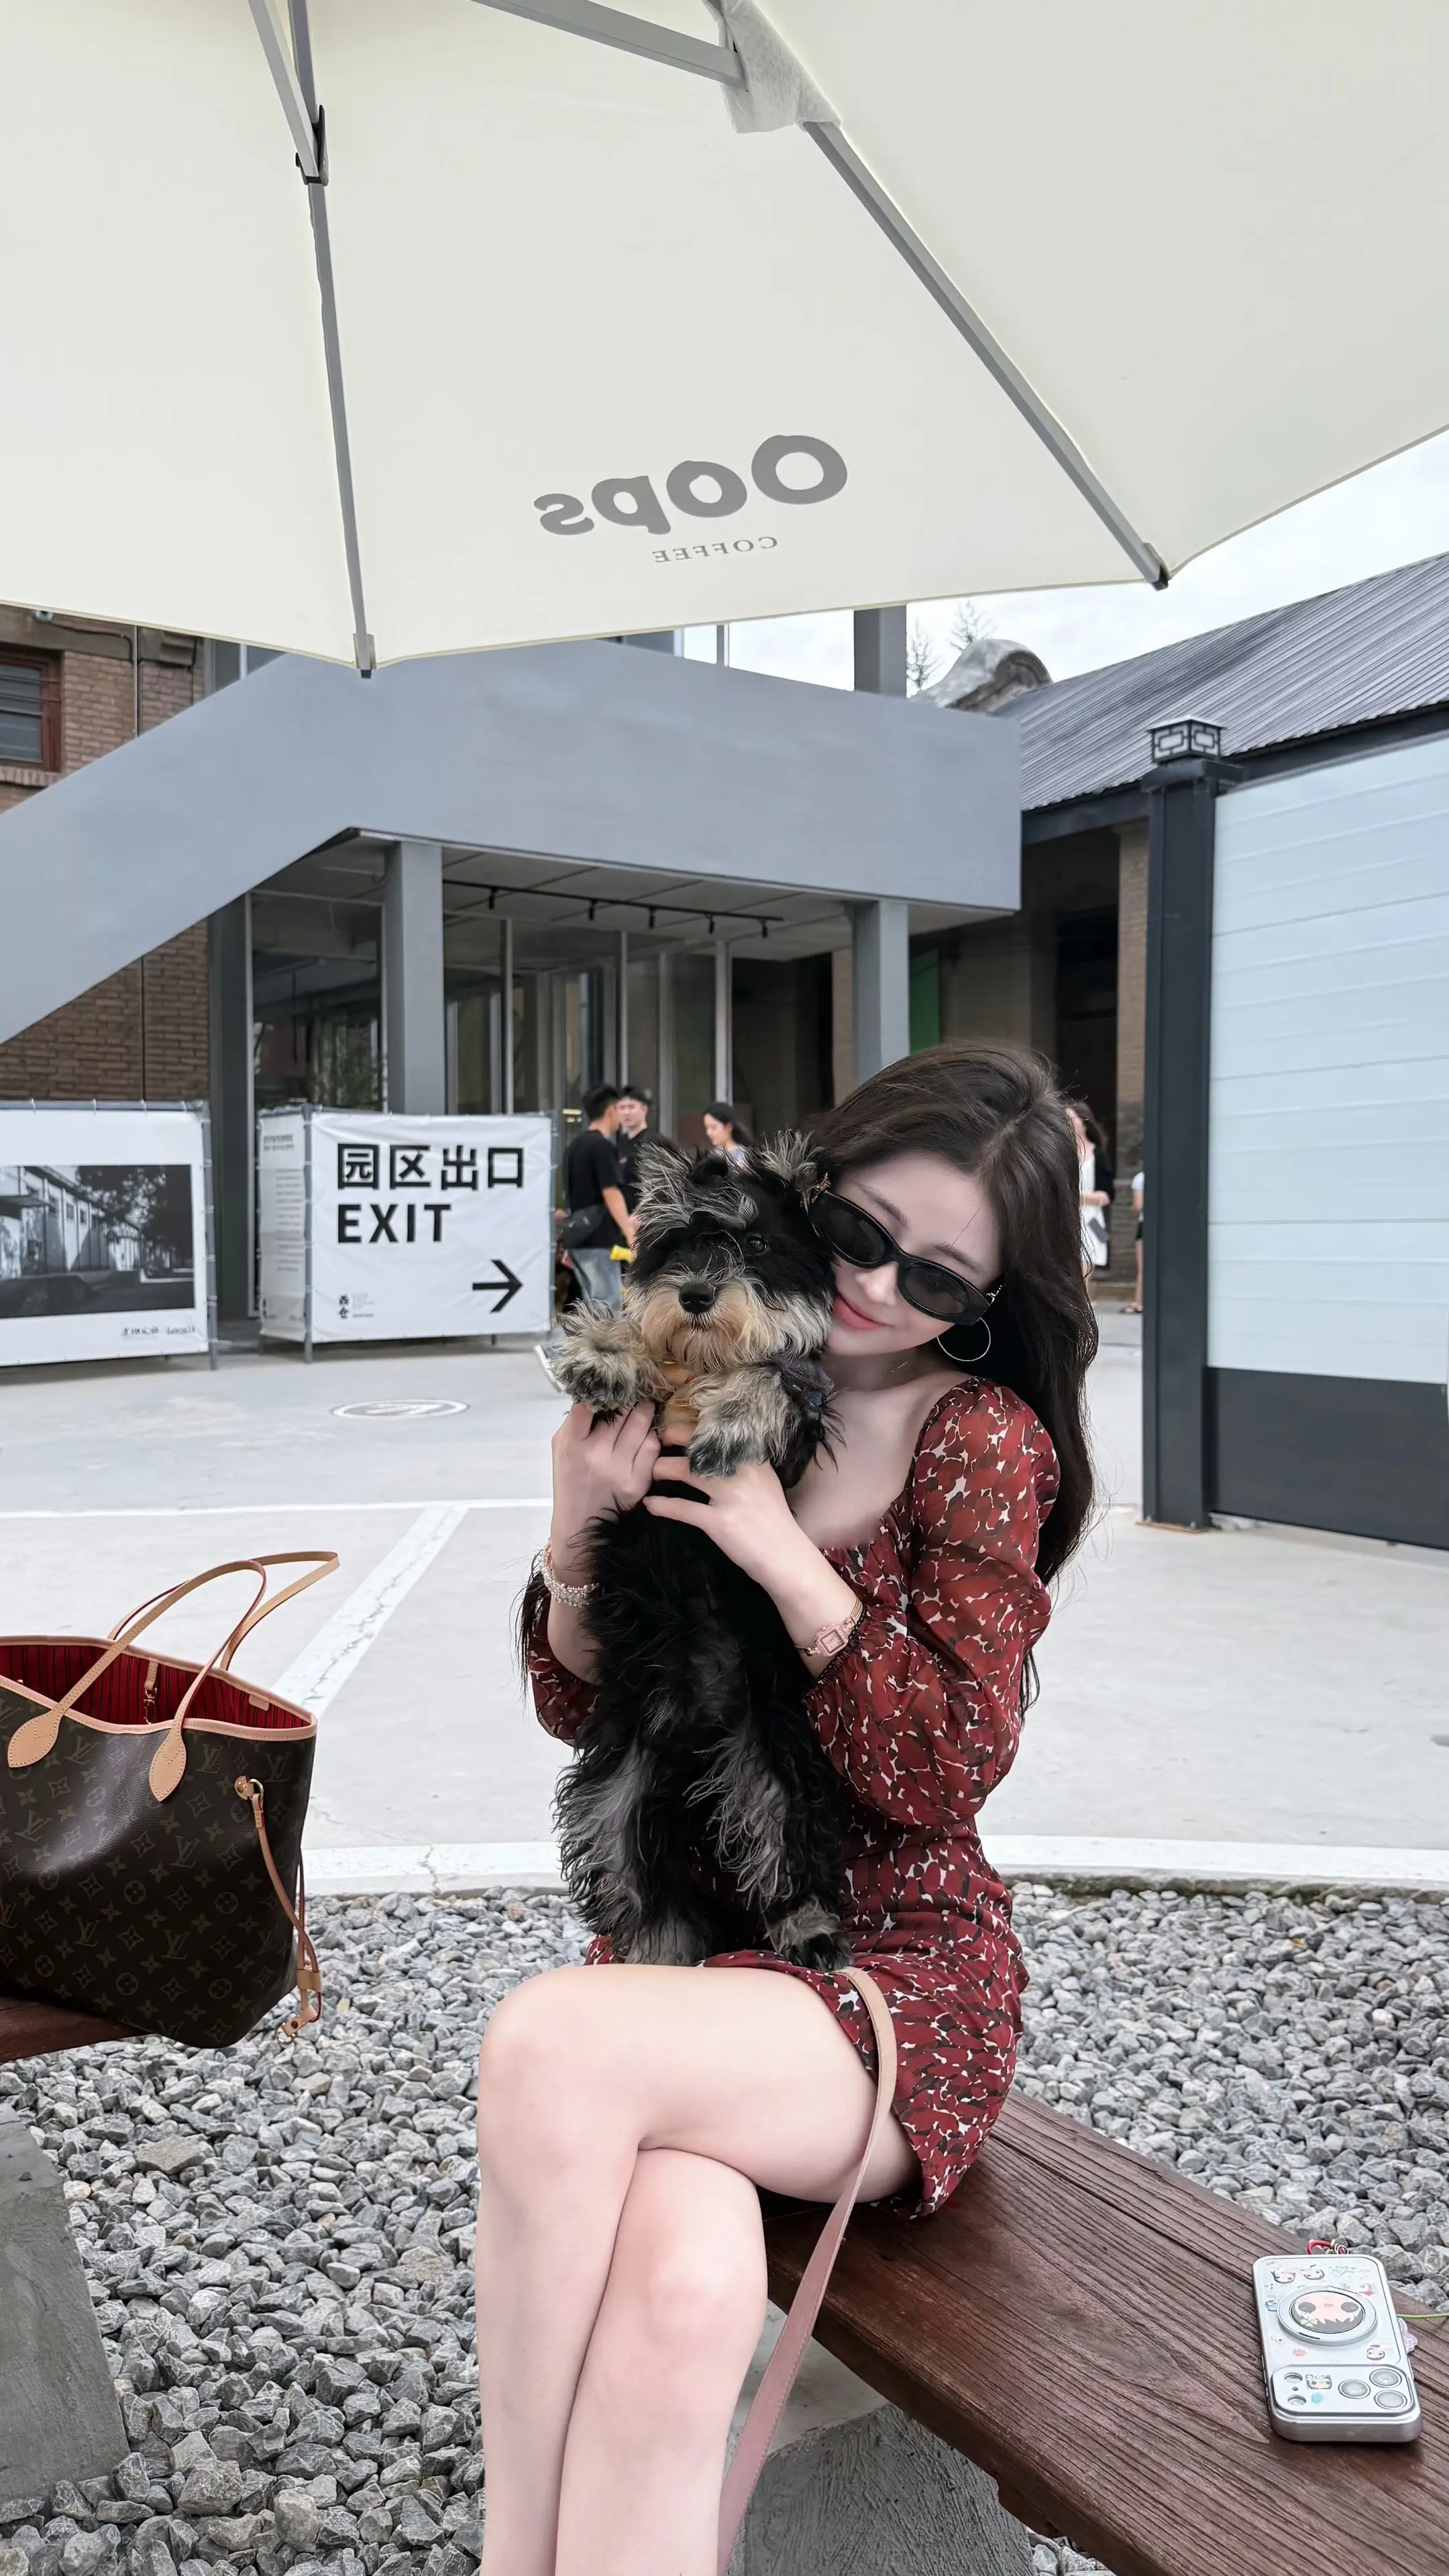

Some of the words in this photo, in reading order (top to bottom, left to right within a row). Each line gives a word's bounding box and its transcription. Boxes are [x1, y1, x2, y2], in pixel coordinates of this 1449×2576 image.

[337, 1142, 525, 1191] 园区出口
[337, 1203, 452, 1244] EXIT
